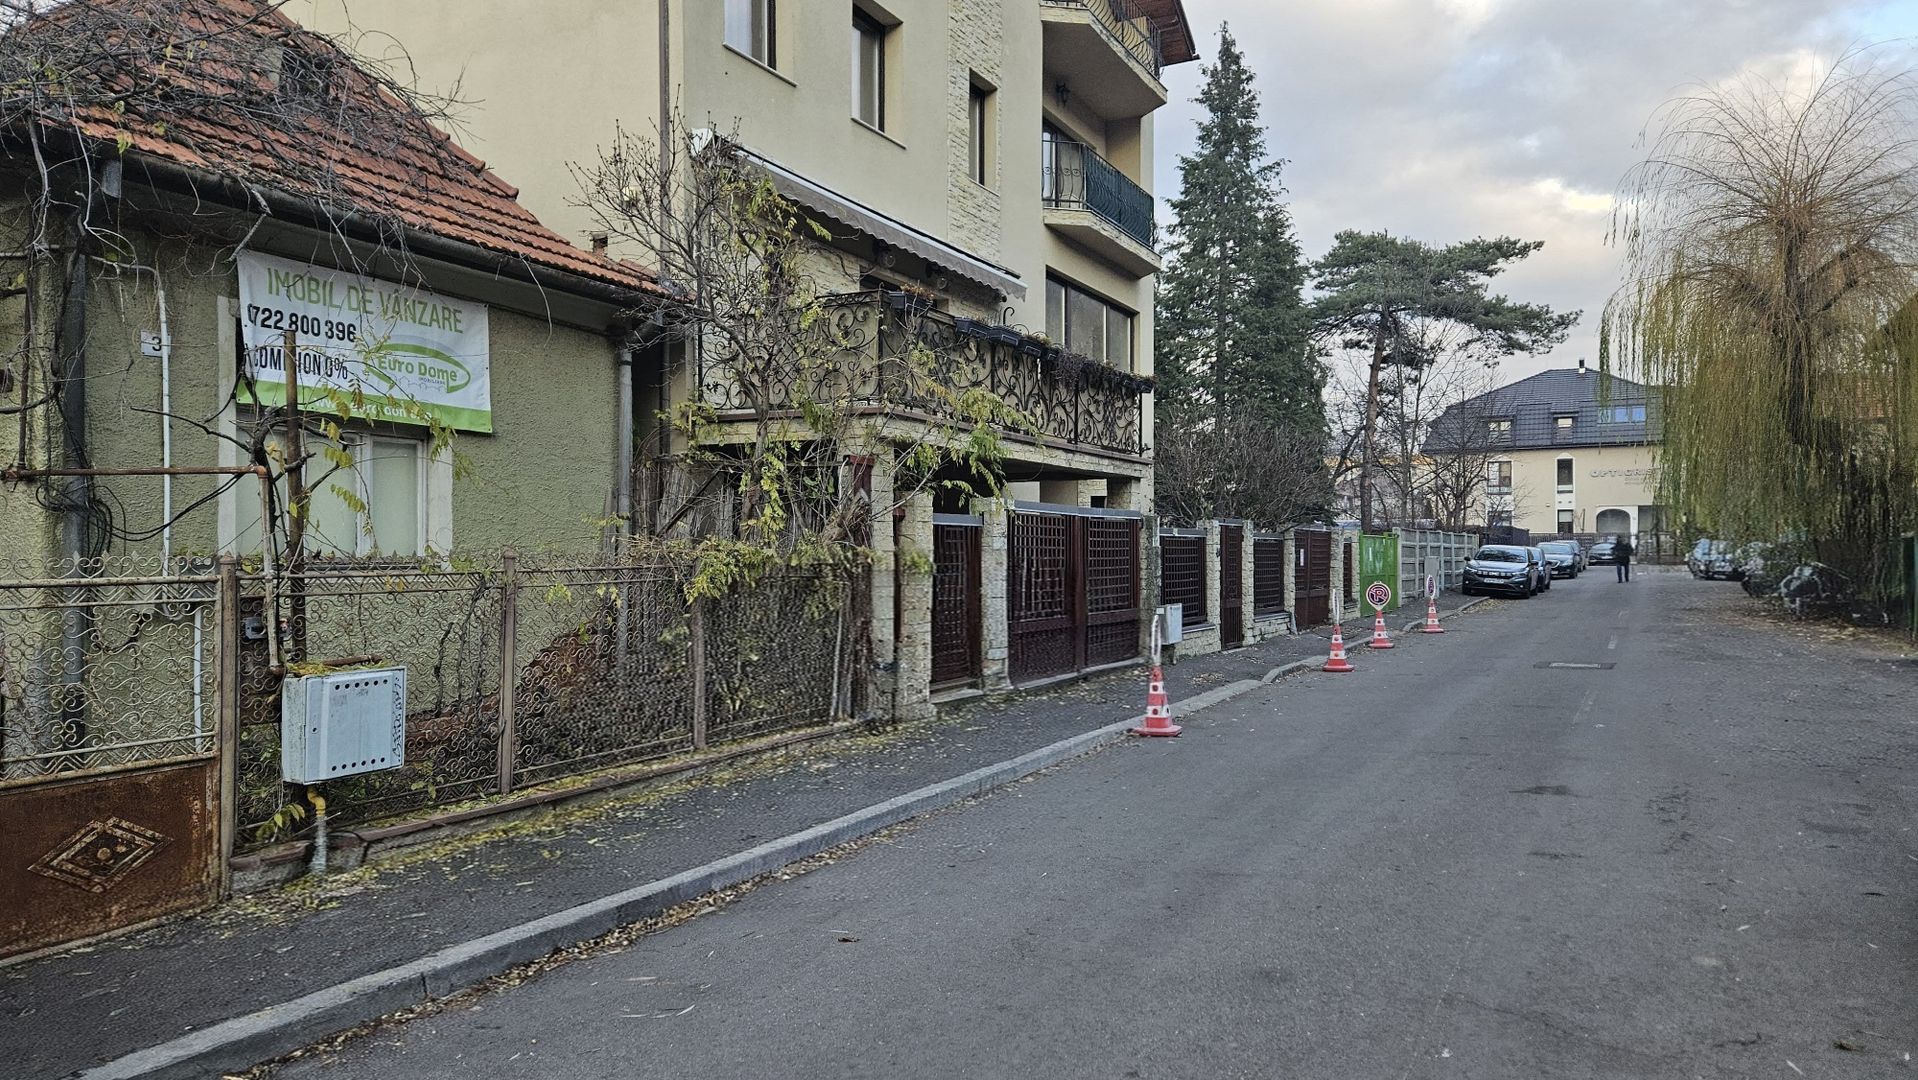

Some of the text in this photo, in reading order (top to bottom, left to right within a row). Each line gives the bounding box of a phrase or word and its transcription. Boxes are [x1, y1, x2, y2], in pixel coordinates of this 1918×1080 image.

[267, 267, 463, 334] IMOBIL DE VÂNZARE
[288, 312, 320, 337] 800
[324, 320, 357, 342] 396
[418, 361, 458, 383] Dome
